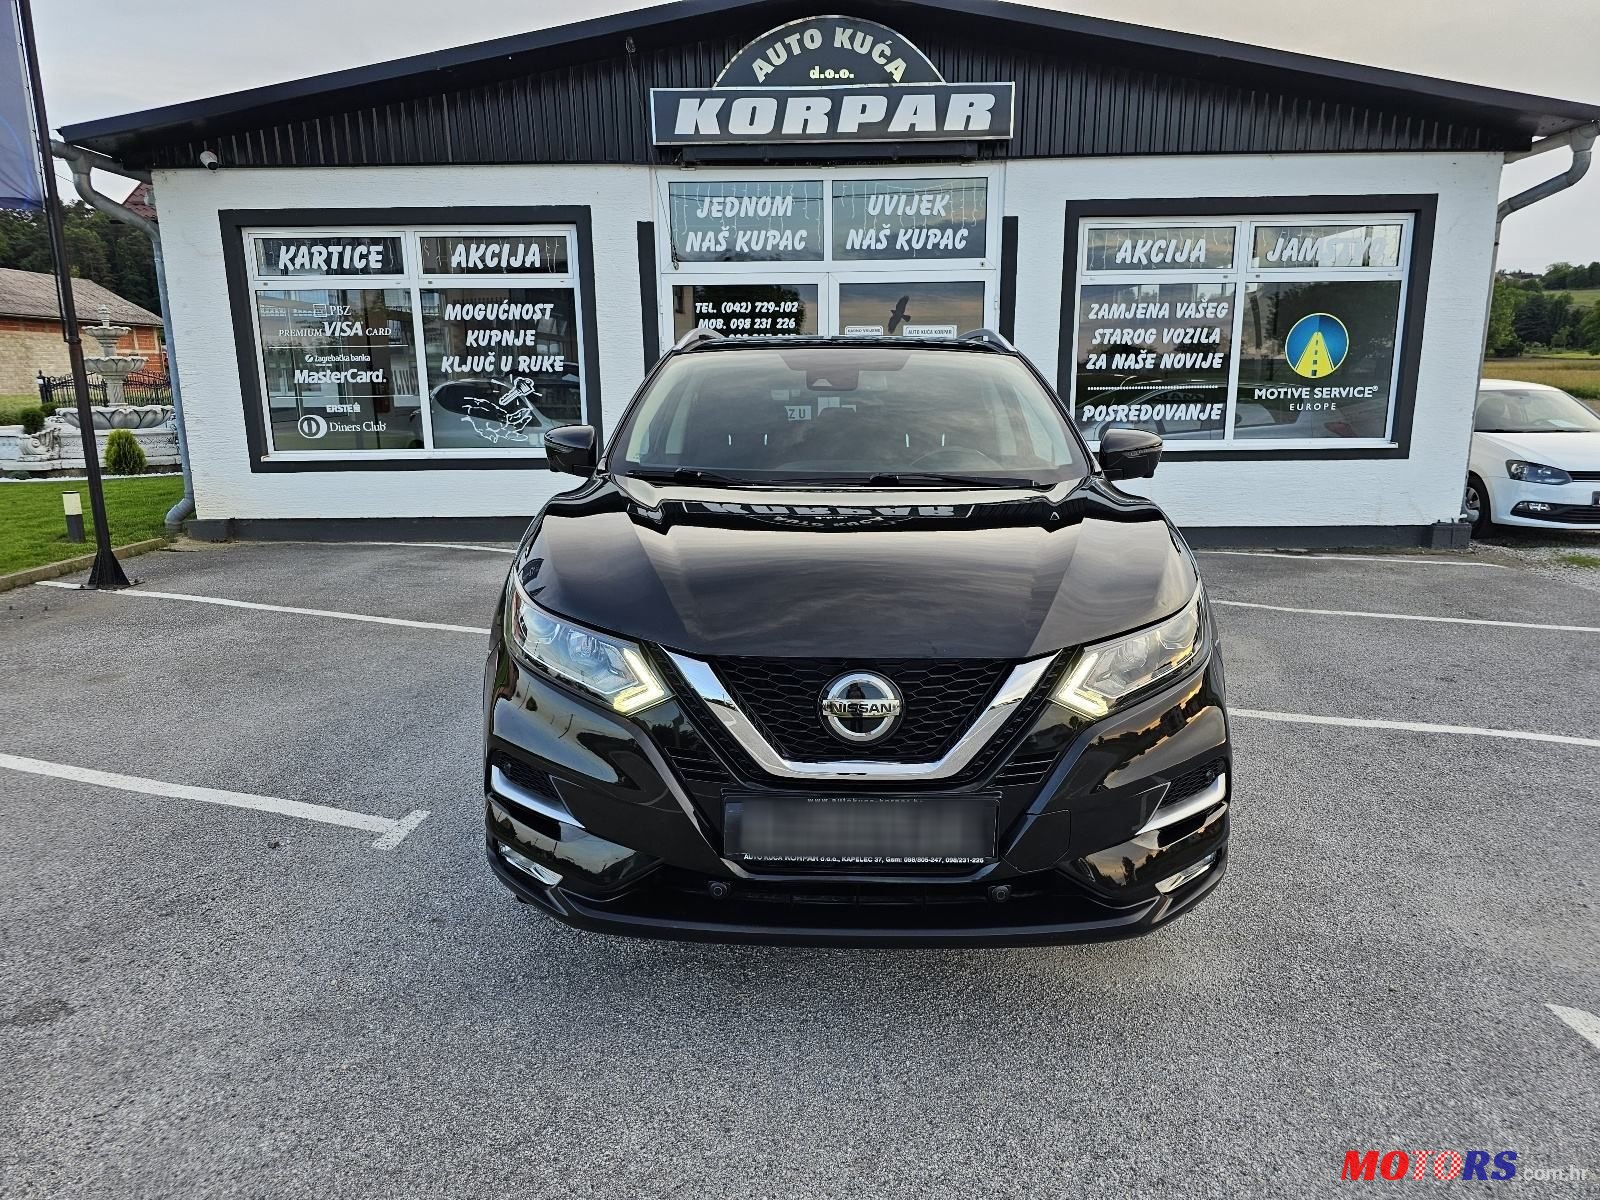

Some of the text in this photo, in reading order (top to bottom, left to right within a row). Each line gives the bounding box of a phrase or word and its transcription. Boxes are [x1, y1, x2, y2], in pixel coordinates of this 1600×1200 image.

[752, 26, 907, 83] AUTO KUĆA
[809, 65, 854, 79] d.o.o.
[674, 93, 995, 135] KORPAR
[697, 196, 793, 218] JEDNOM
[868, 194, 951, 216] UVIJEK
[686, 226, 807, 253] NAŠ KUPAC
[846, 224, 968, 251] NAŠ KUPAC
[279, 245, 383, 270] KARTICE
[452, 243, 541, 268] AKCIJA
[1115, 238, 1207, 265] AKCIJA
[330, 305, 352, 316] PBZ
[444, 299, 554, 320] MOGUĆNOST
[695, 302, 799, 313] TEL. (042) 729-102
[1088, 298, 1229, 319] ZAMJENA VAŠEG
[279, 321, 391, 337] PREMIUM VISA CARD
[698, 318, 796, 329] MOB. 098 231 226
[466, 329, 536, 347] KUPNJE
[1092, 327, 1220, 345] STAROG VOZILA
[350, 353, 370, 361] banka
[441, 352, 564, 373] KLJUČ U RUKE
[1086, 349, 1224, 369] ZA NAŠE NOVIJE
[1254, 387, 1310, 400] MOTIVE
[326, 404, 353, 413] ERSTE
[1082, 403, 1223, 422] POSREDOVANJE
[1289, 402, 1336, 411] EUROPE
[329, 421, 386, 432] Diners Club
[833, 703, 892, 713] NISSAN
